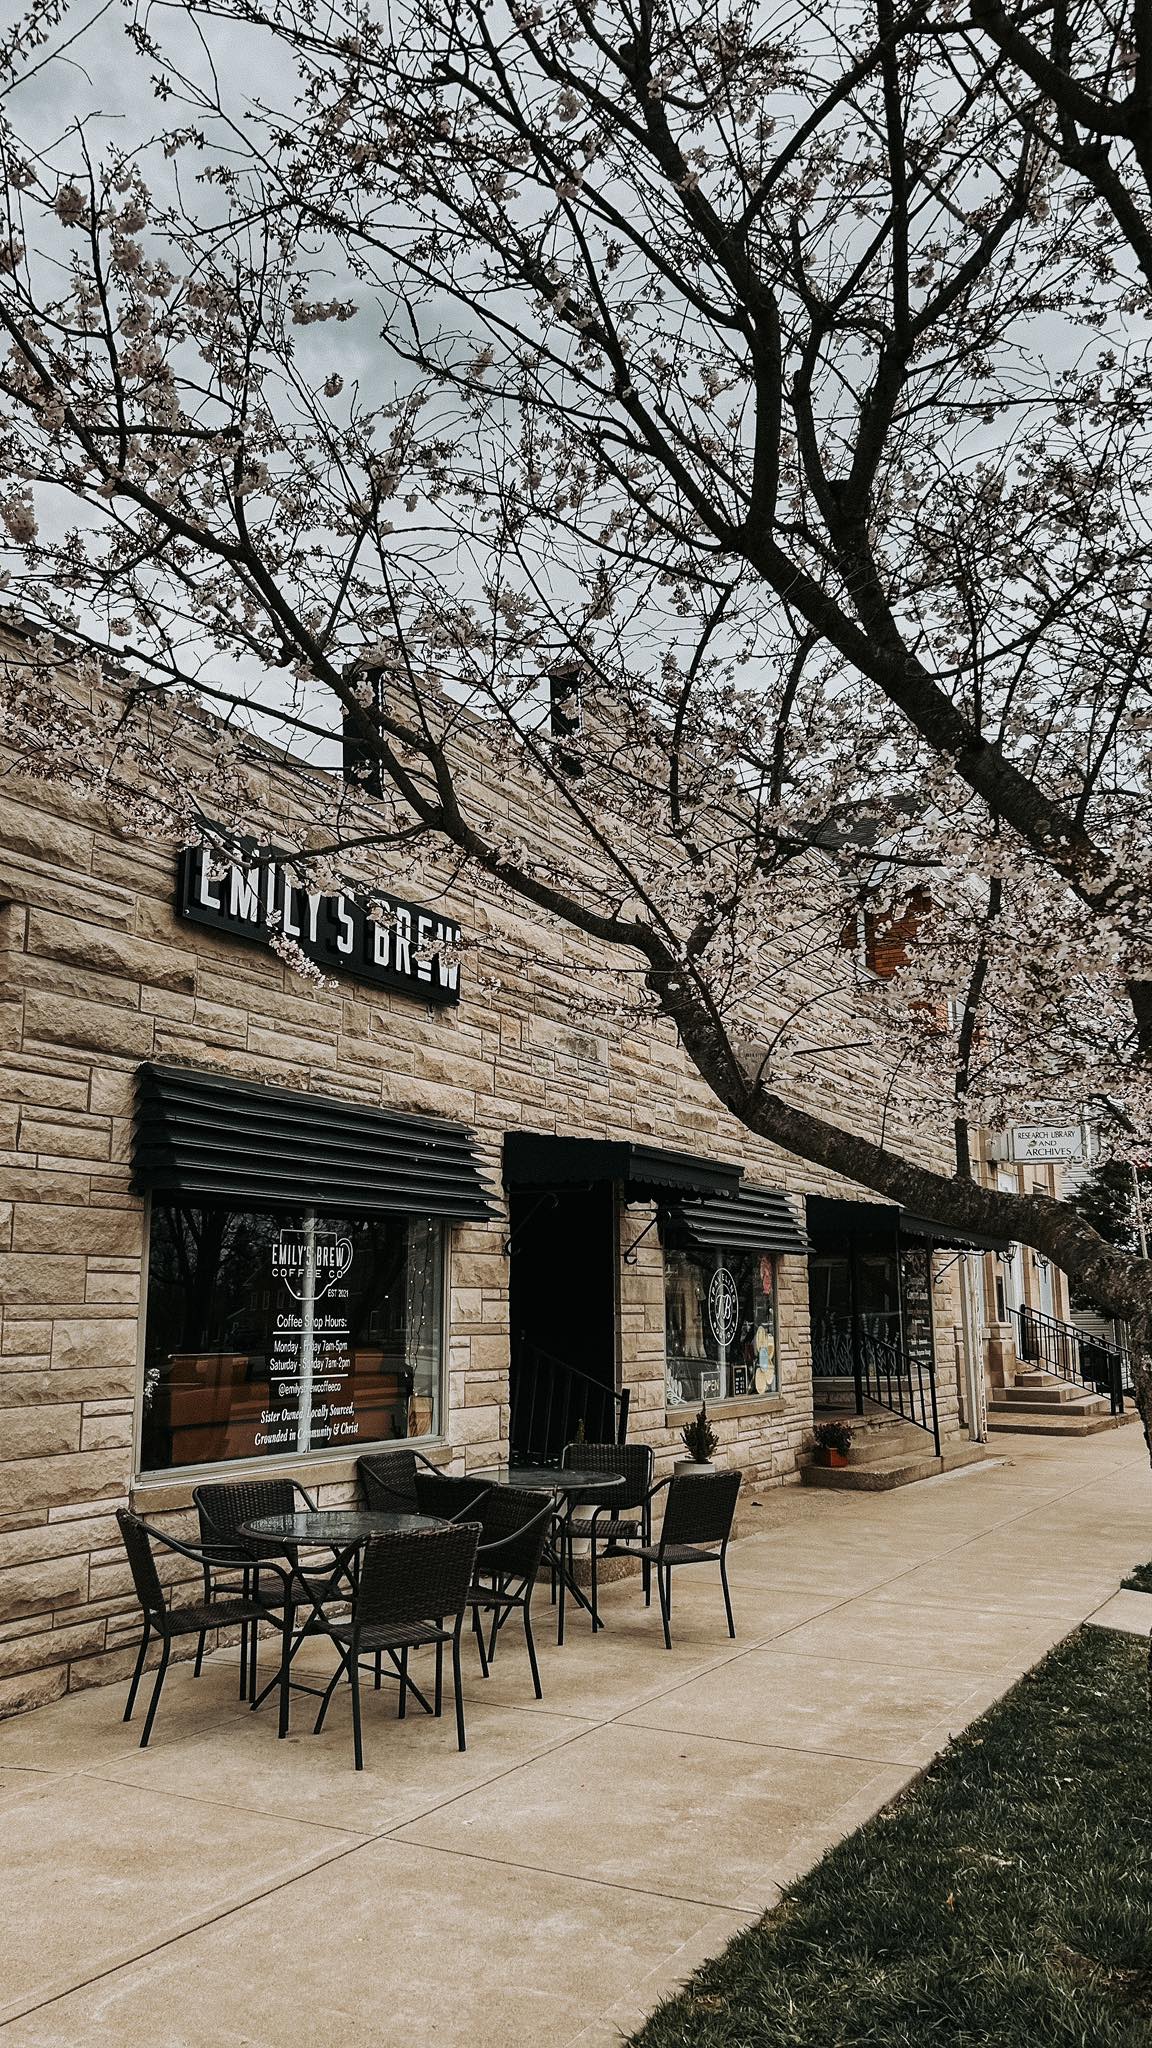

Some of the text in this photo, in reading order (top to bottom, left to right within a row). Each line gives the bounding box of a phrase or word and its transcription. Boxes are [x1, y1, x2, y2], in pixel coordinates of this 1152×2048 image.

[201, 849, 461, 990] EMILYS BREW
[1017, 1130, 1075, 1139] RESEARCH LIBRARY
[1025, 1147, 1072, 1156] ARCHIVES
[271, 1243, 344, 1267] EMILY'S BREW
[271, 1267, 343, 1279] COFFEE CO
[327, 1288, 349, 1298] EST 2021
[276, 1313, 303, 1328] Coffee
[325, 1314, 348, 1328] Hours:
[273, 1340, 299, 1355] Monday
[322, 1339, 348, 1354] 7am-5pm
[269, 1357, 298, 1373] Saturday
[324, 1356, 351, 1371] 7am-2pm
[278, 1380, 342, 1397] @emilysewcoffeeco
[260, 1409, 281, 1424] Sister
[329, 1401, 355, 1417] Sourced,
[254, 1421, 359, 1446] Grounded in Comunity & Christ
